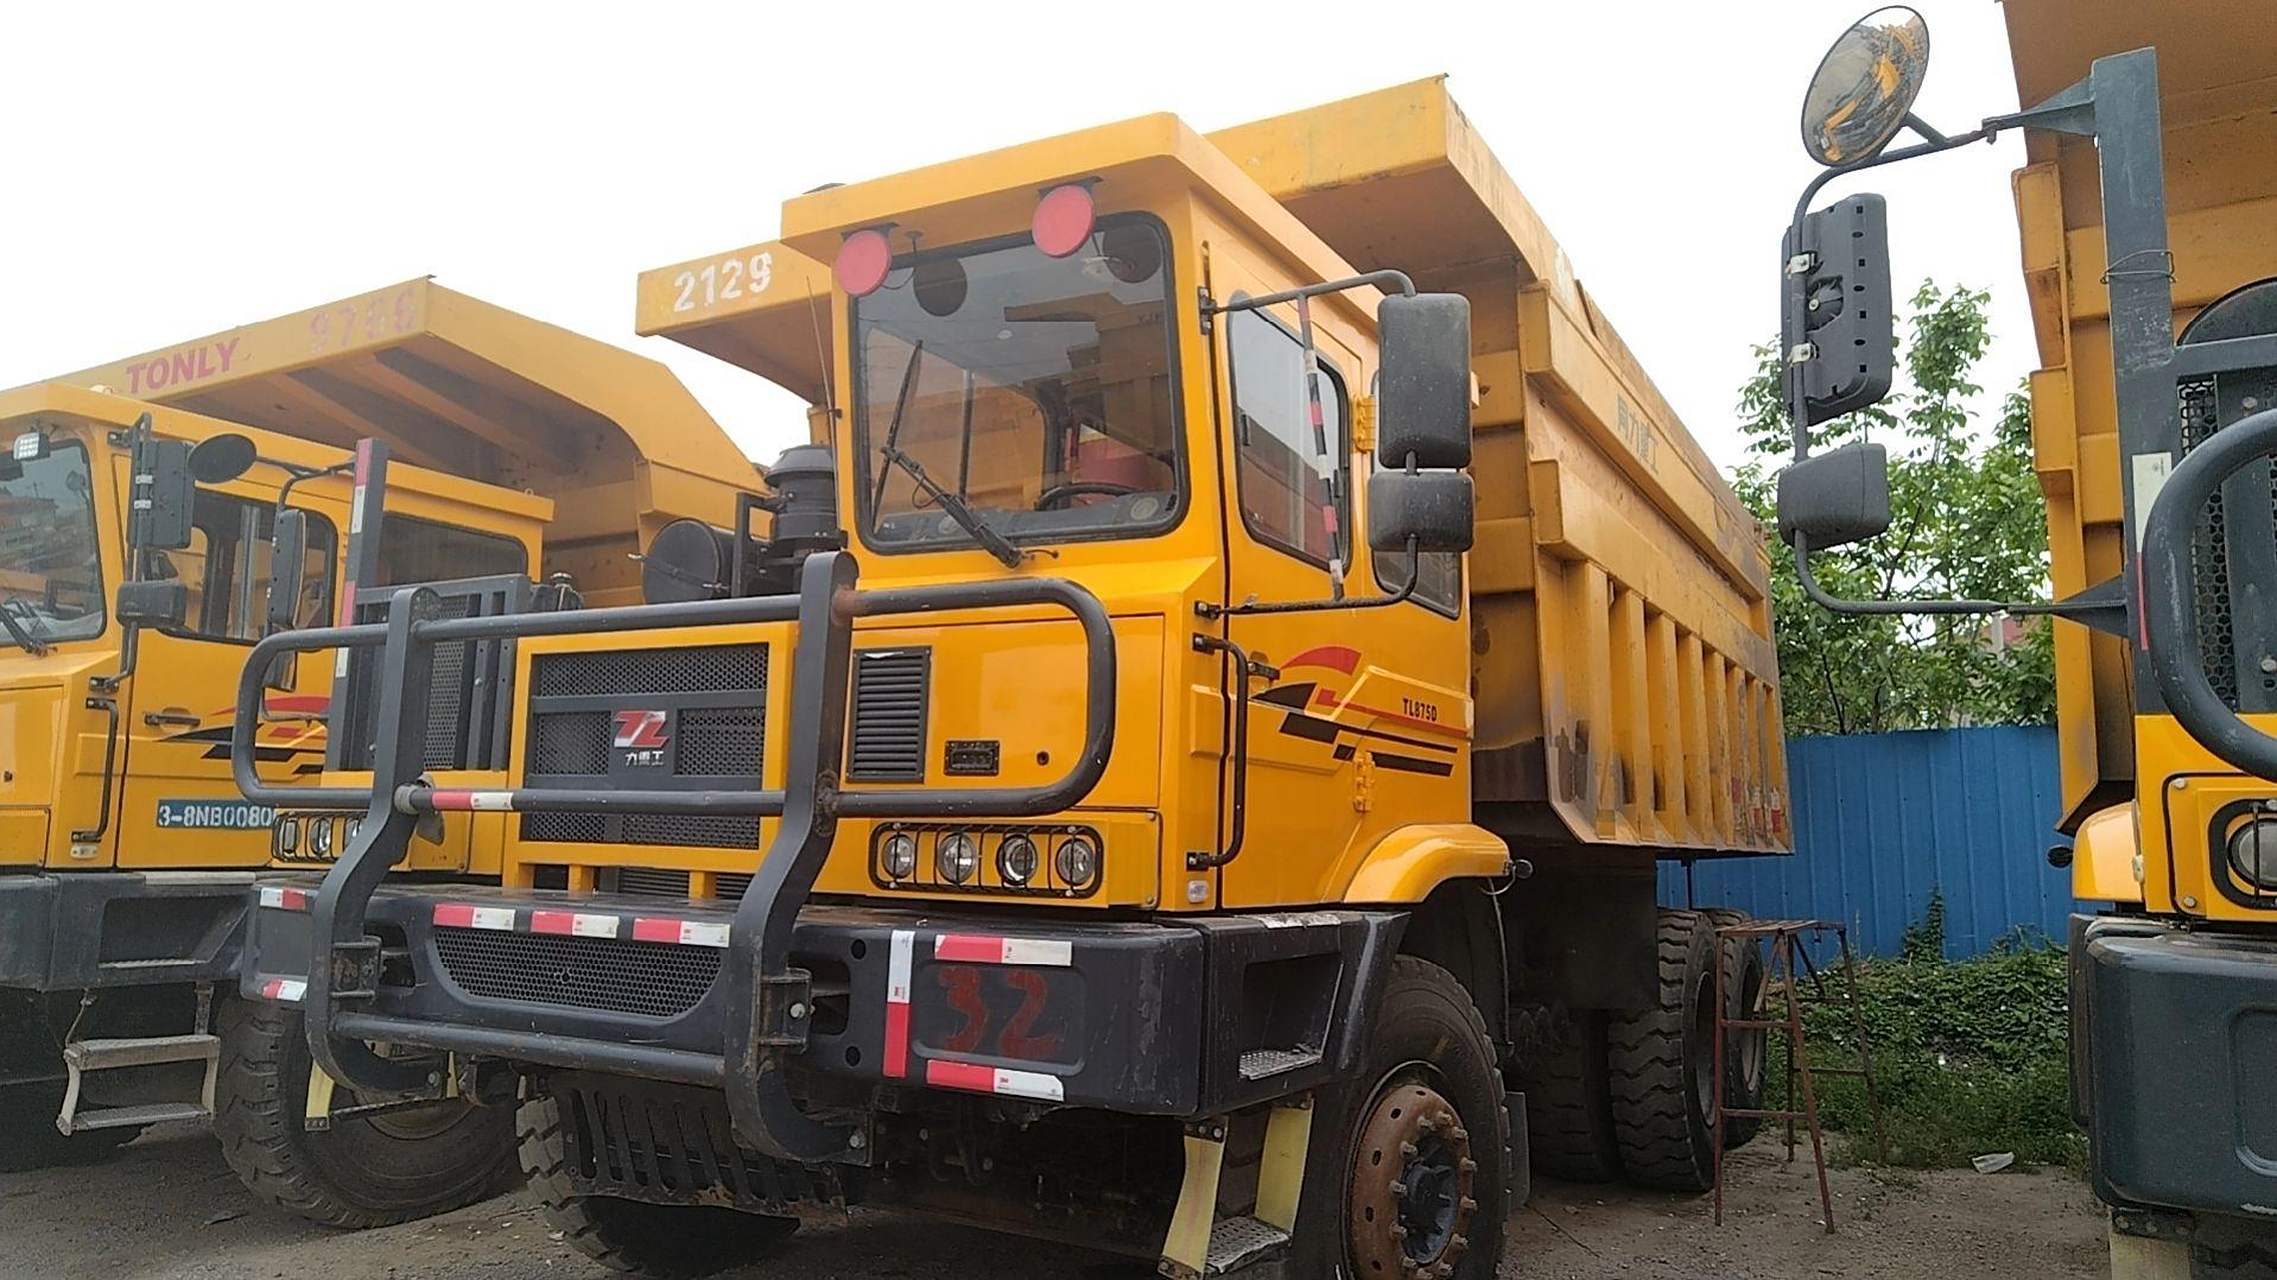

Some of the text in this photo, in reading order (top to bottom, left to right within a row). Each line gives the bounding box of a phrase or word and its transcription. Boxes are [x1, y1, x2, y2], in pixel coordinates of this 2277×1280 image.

[673, 252, 773, 312] 2129
[125, 336, 241, 394] TONLY
[158, 804, 278, 828] 3-8NB0080
[940, 966, 1058, 1058] 32
